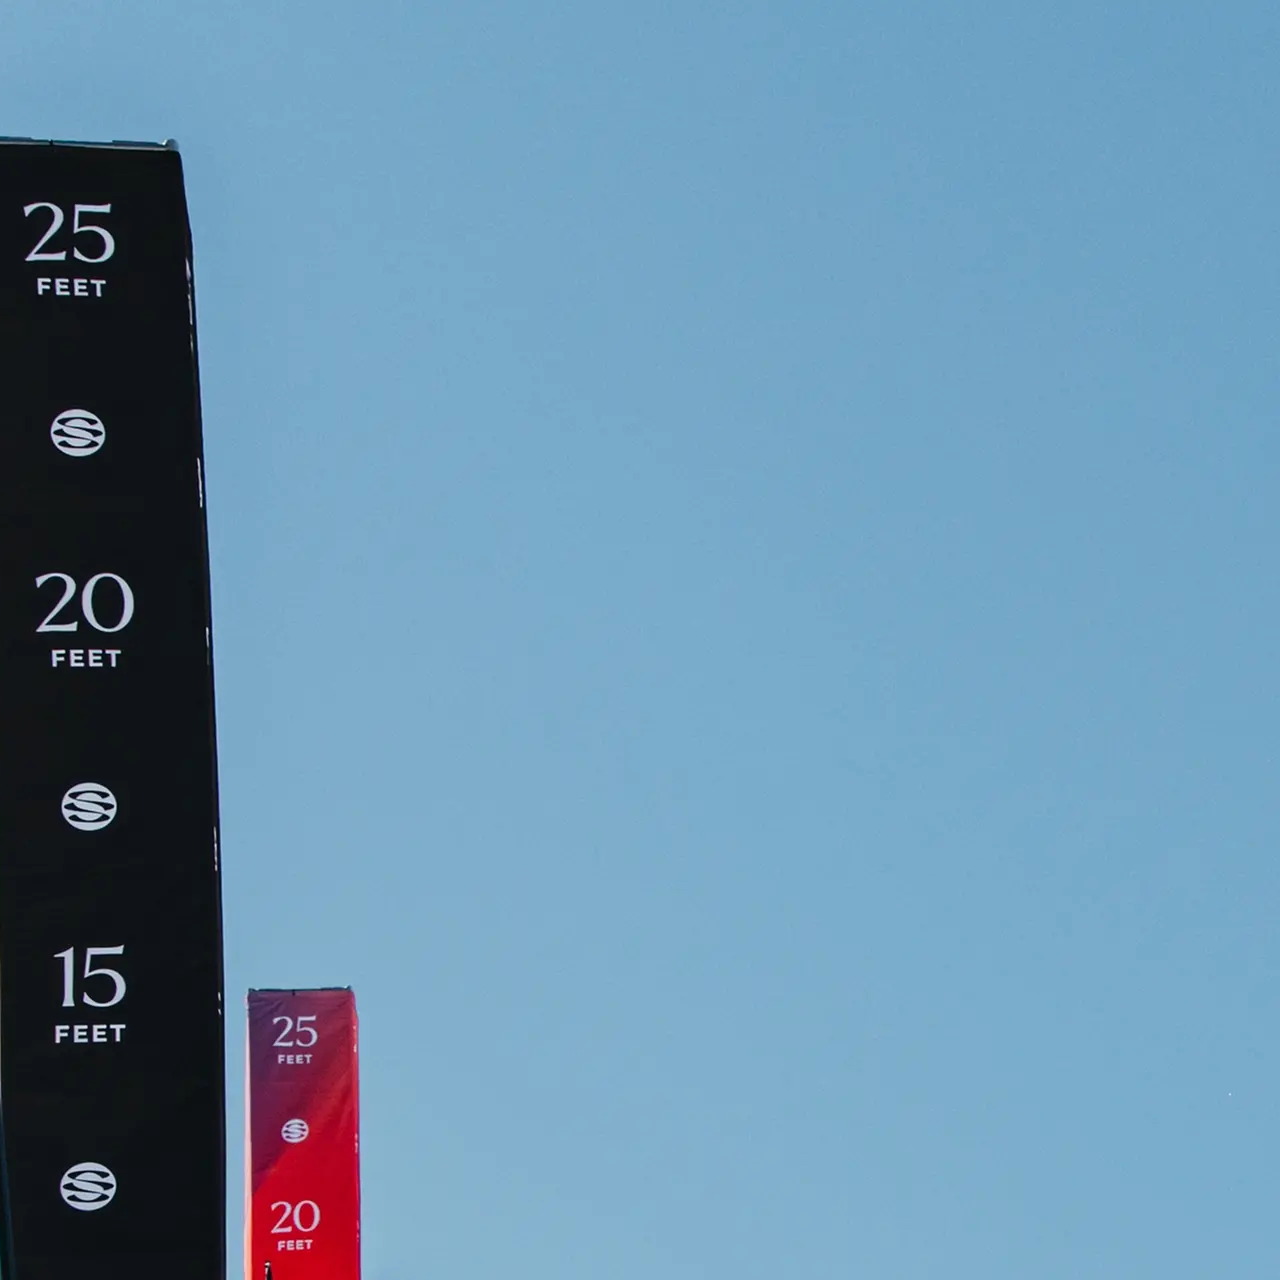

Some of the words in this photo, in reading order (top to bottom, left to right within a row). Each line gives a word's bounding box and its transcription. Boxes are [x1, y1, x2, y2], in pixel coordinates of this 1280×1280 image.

[24, 203, 114, 263] 25
[38, 278, 106, 297] FEET
[36, 573, 134, 632] 20
[52, 650, 121, 667] FEET
[54, 945, 126, 1007] 15
[55, 1024, 126, 1043] FEET
[273, 1016, 317, 1047] 25
[278, 1054, 312, 1064] FEET
[271, 1200, 320, 1233] 20
[278, 1240, 313, 1251] FEET
